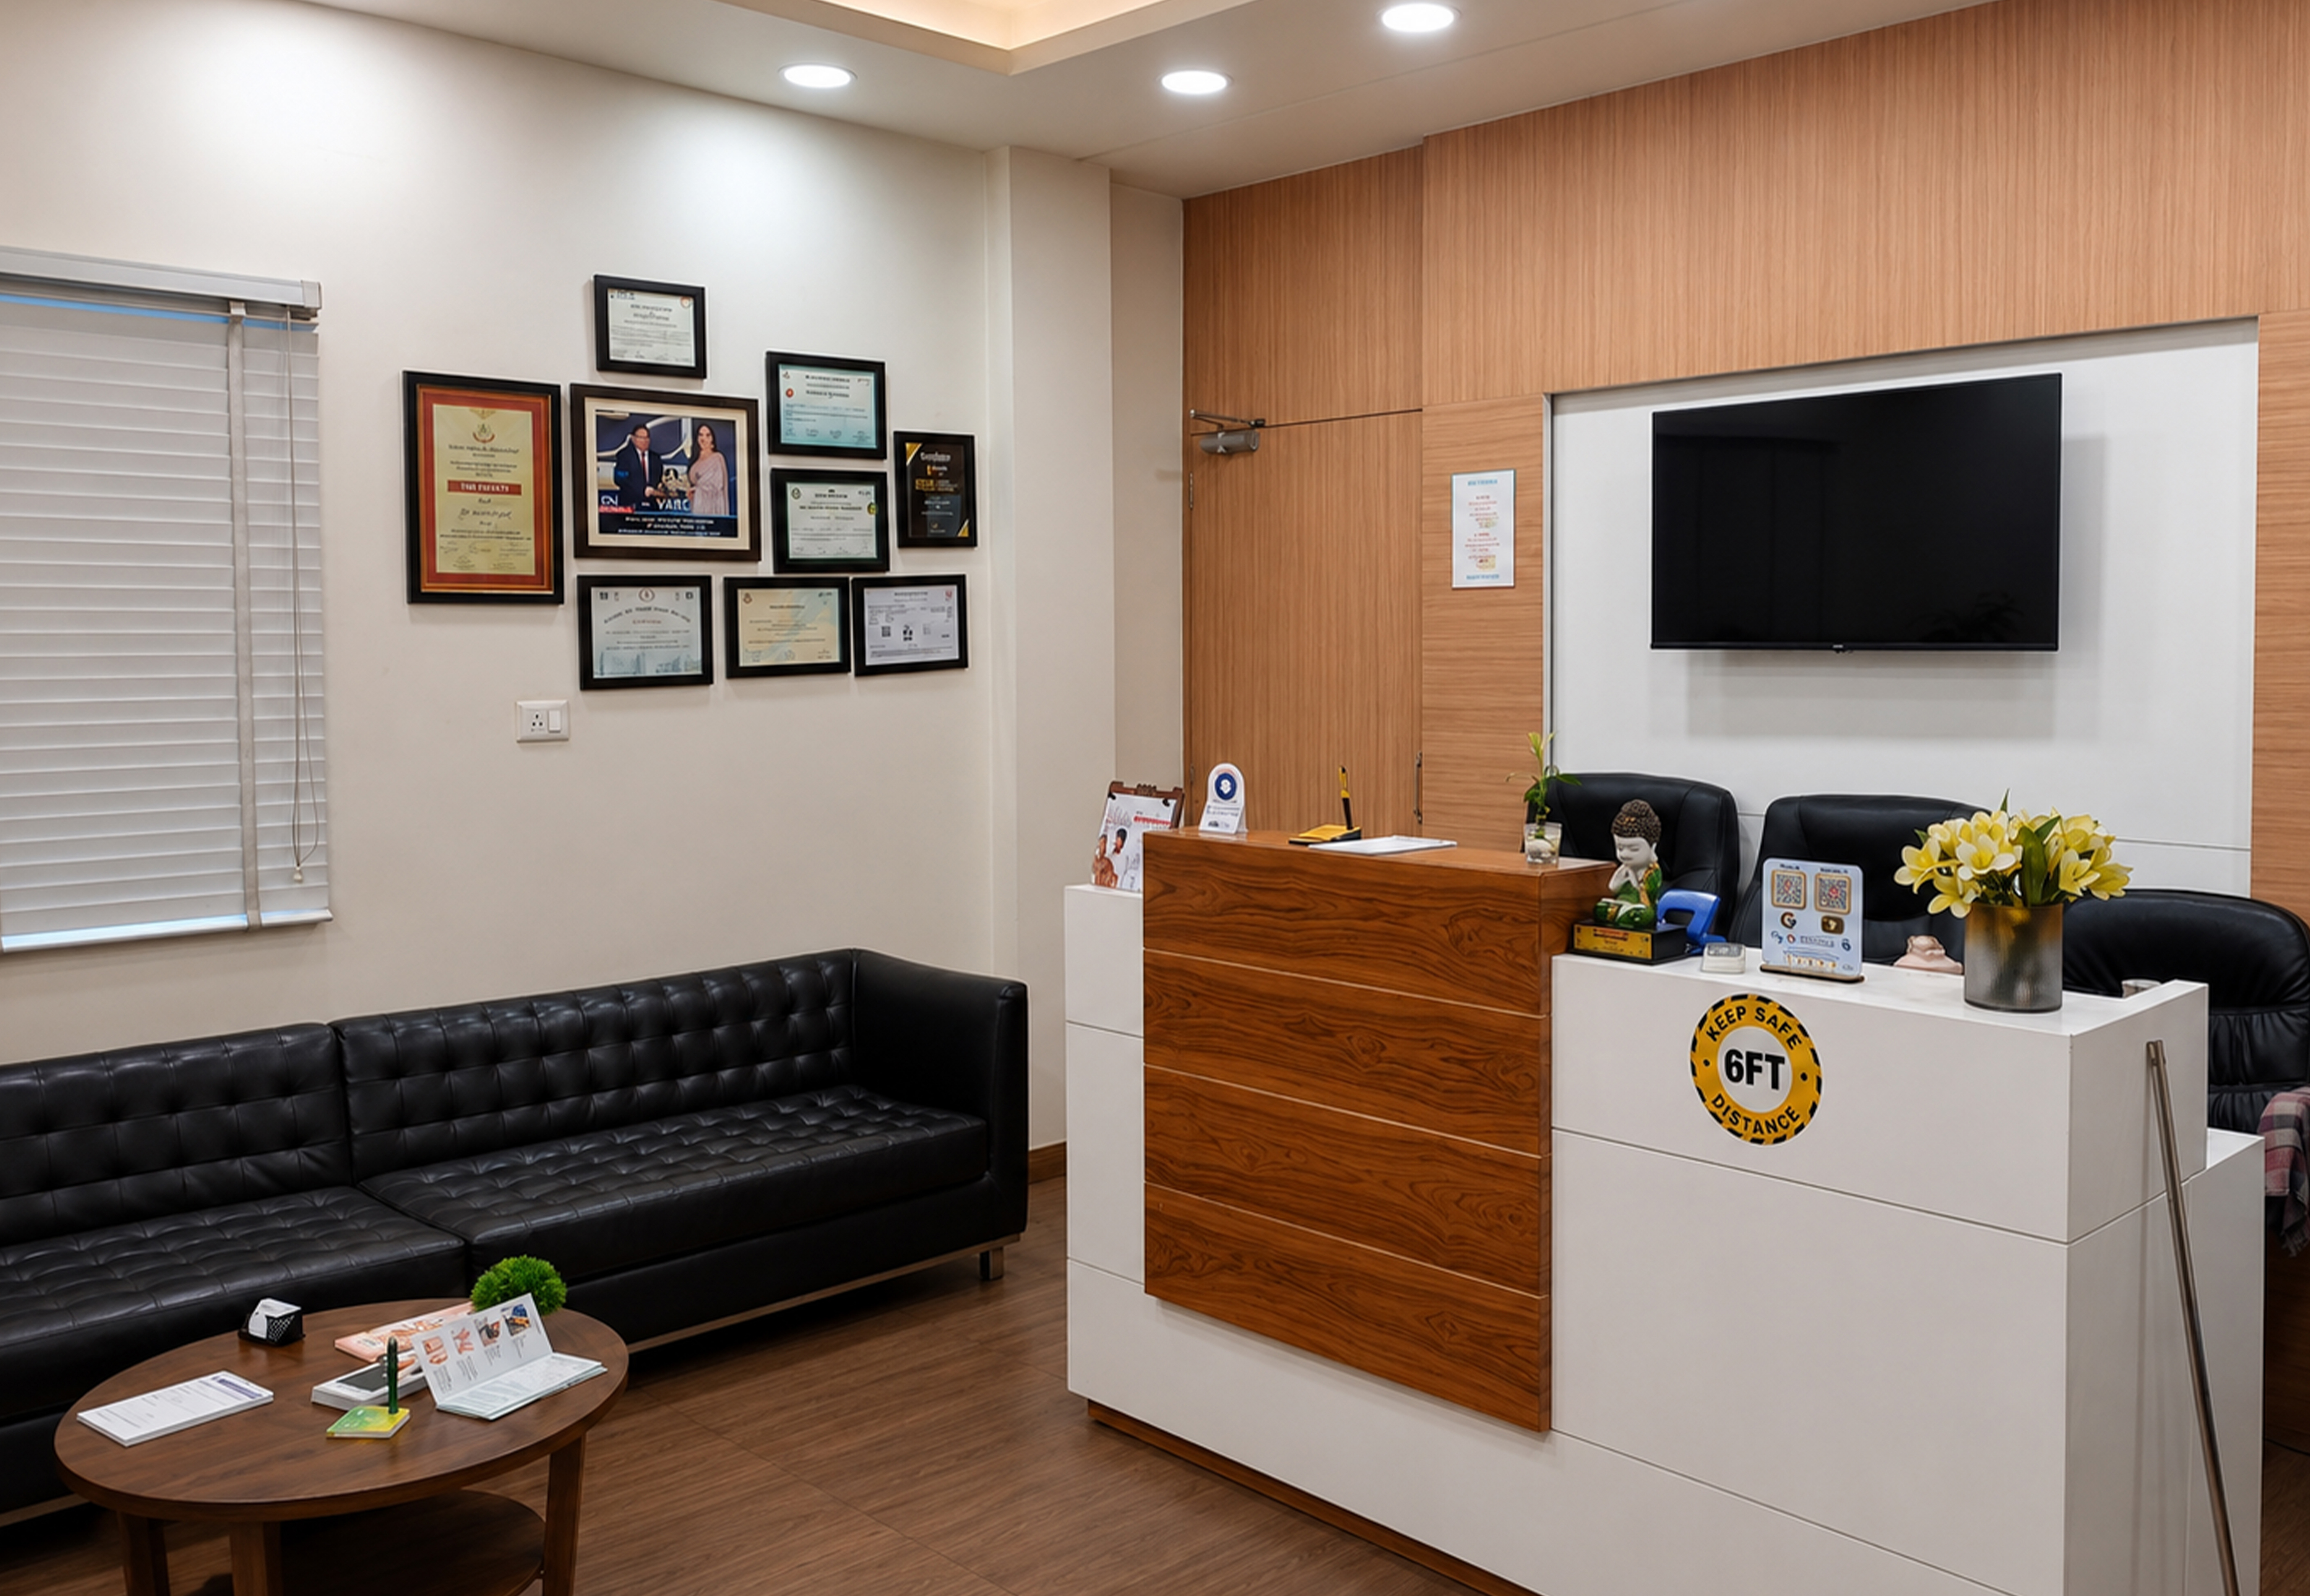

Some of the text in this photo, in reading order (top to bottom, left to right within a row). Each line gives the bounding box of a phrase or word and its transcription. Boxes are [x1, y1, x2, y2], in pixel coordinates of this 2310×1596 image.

[1706, 1006, 1802, 1050] KEEP SAFE
[1725, 1049, 1785, 1090] 6FT
[1711, 1093, 1800, 1134] DISTANCE
